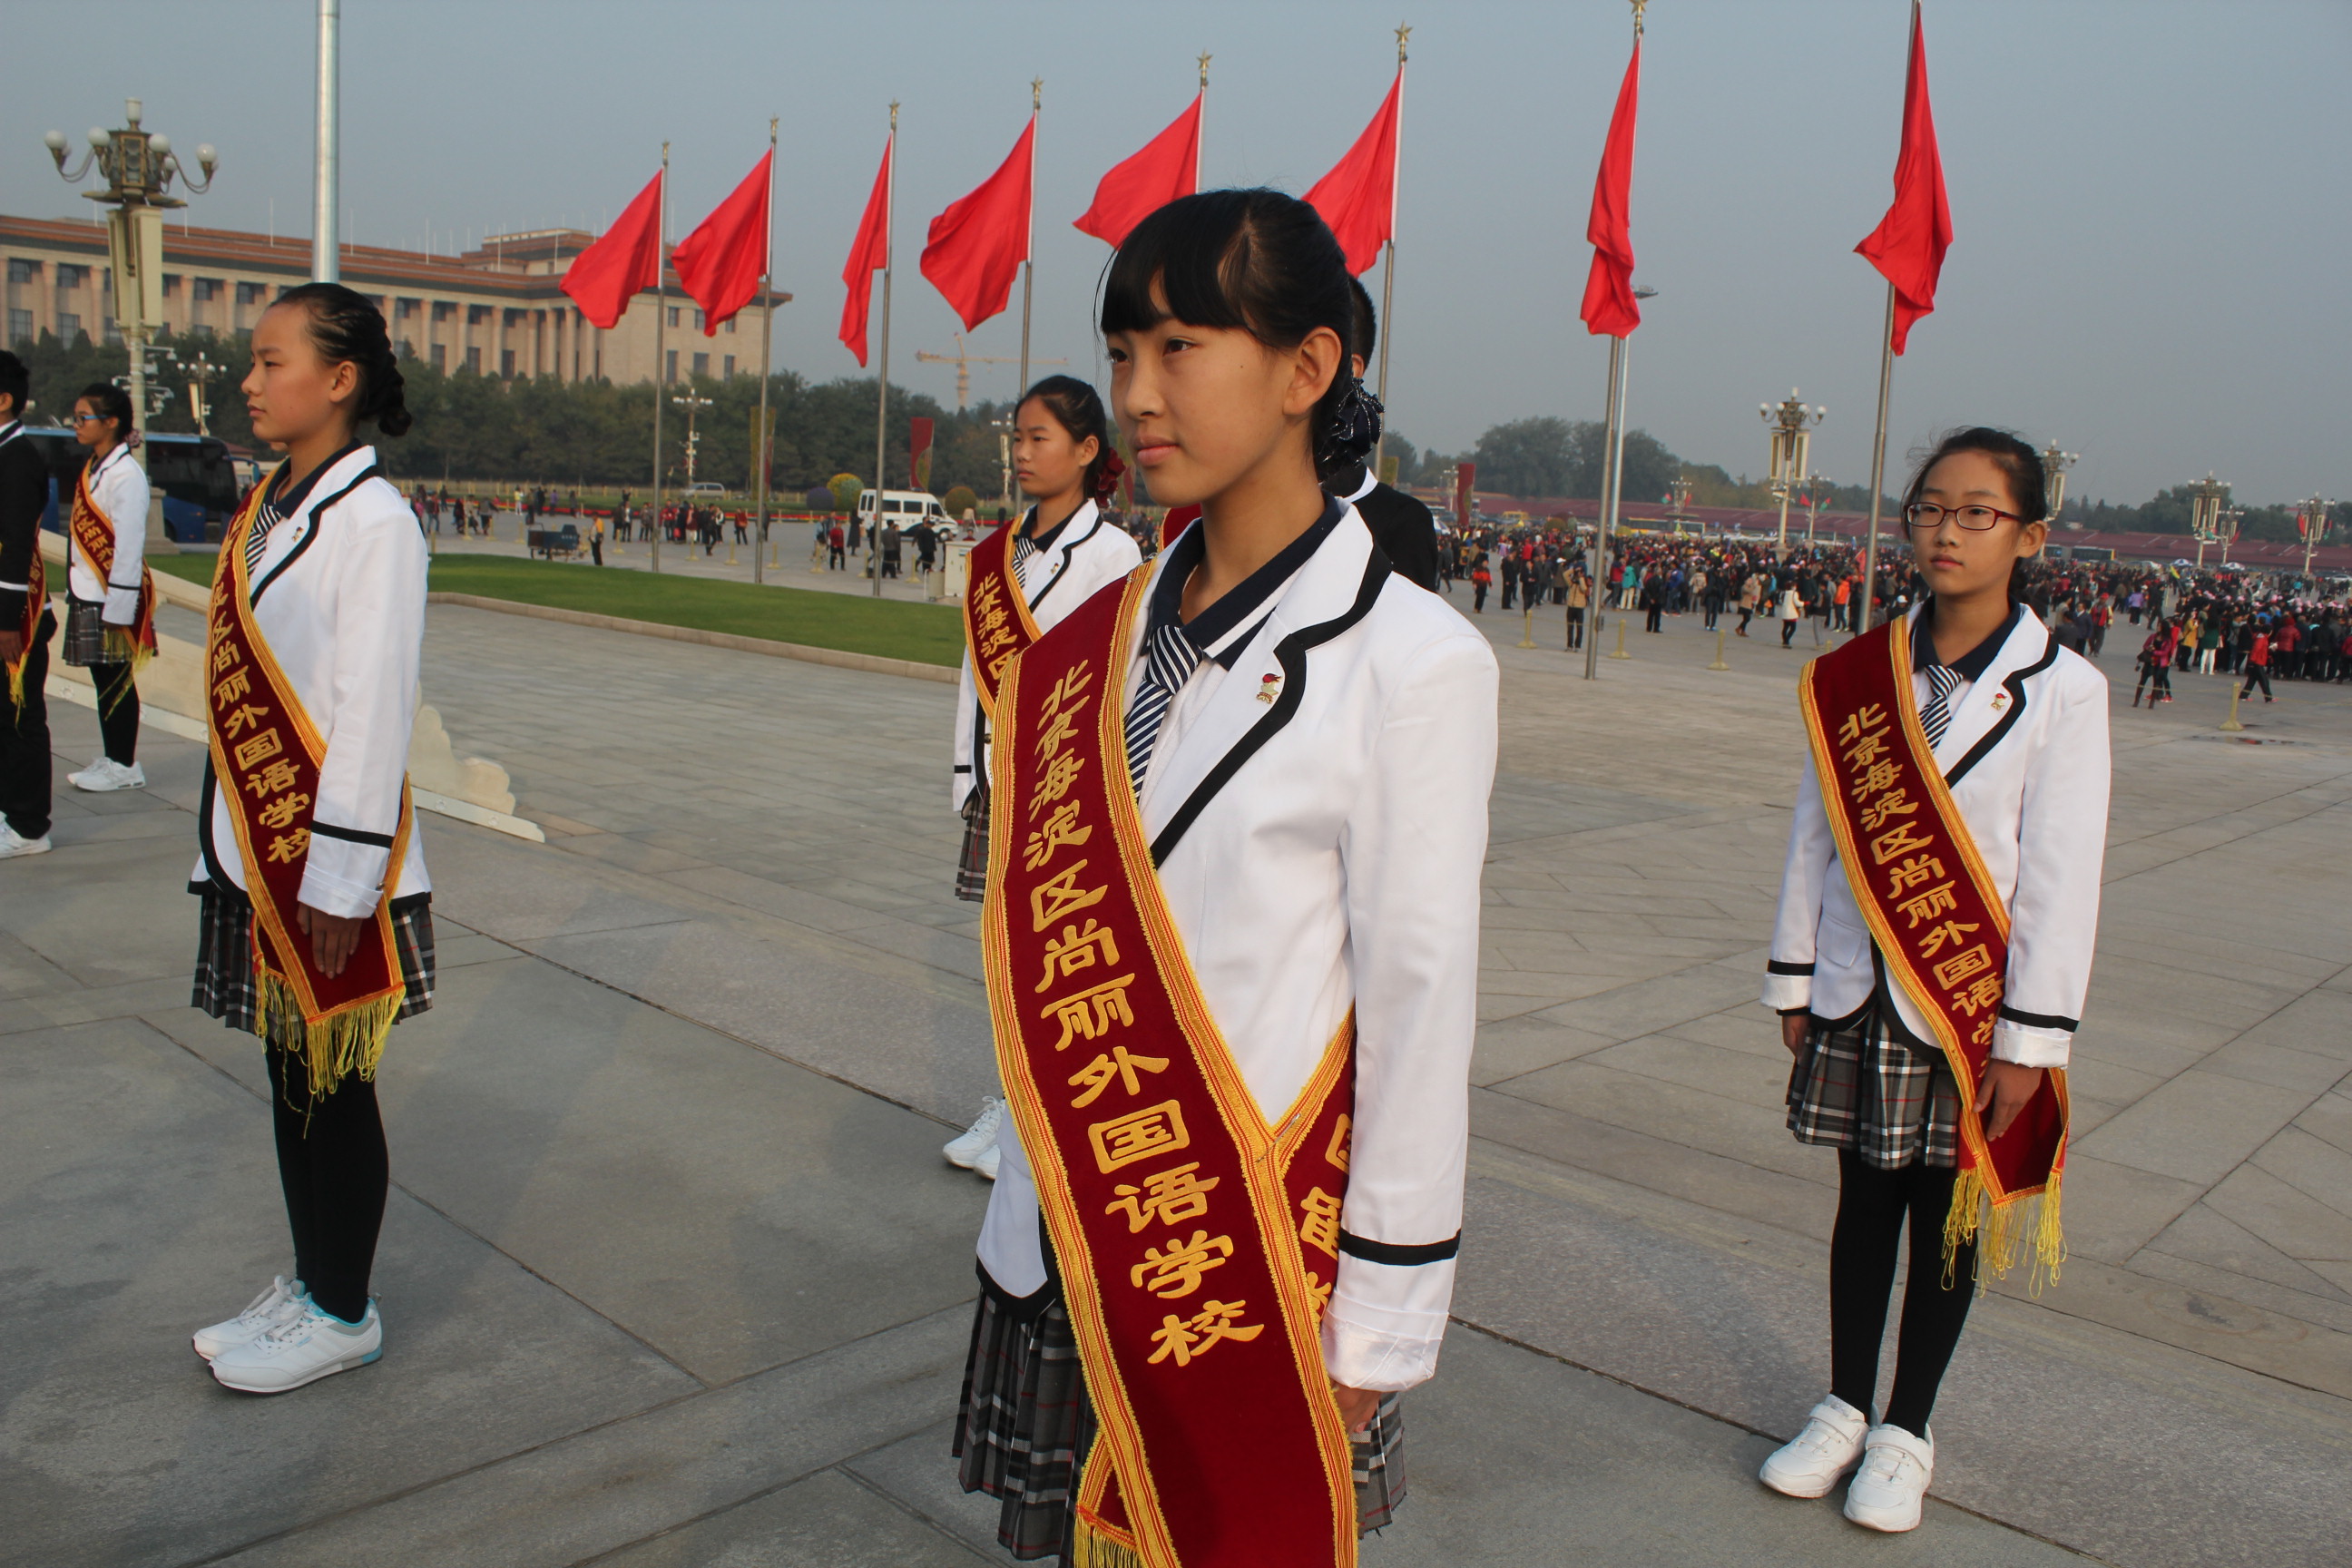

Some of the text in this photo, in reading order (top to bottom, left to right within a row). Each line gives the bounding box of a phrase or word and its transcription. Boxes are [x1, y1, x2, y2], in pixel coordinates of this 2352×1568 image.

[1024, 660, 1265, 1367] 北京海淀区尚丽外国语学校
[1838, 703, 2005, 1077] 北京海淀区尚丽外国语
